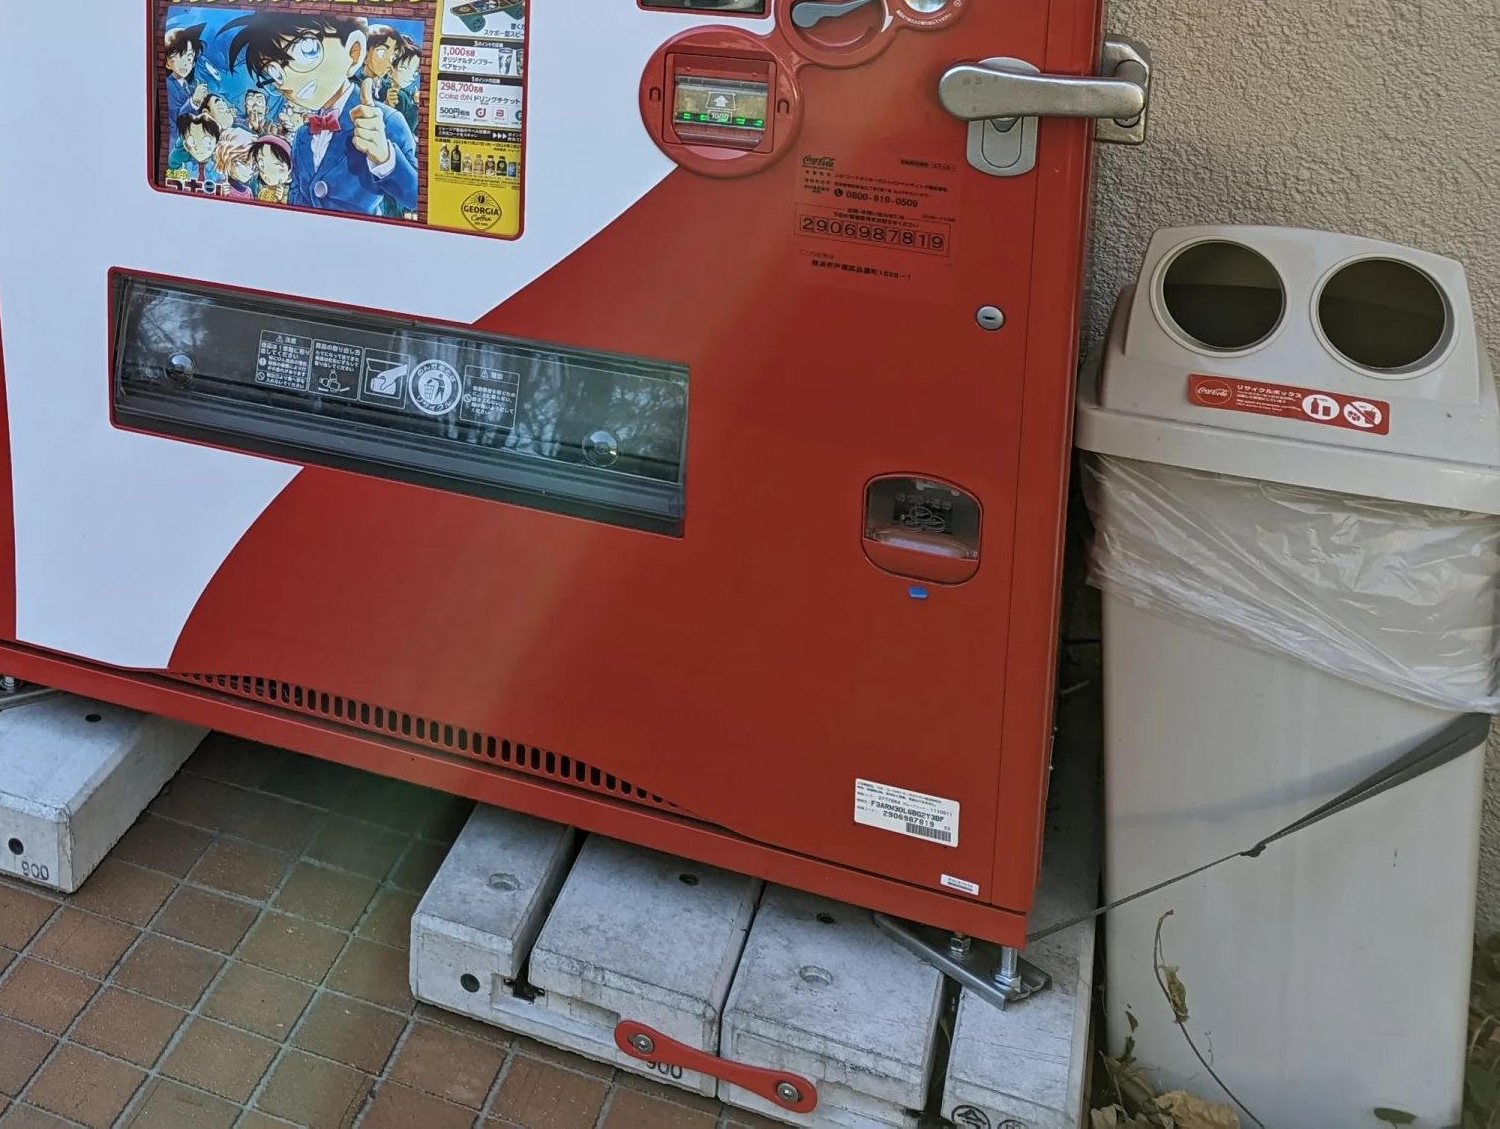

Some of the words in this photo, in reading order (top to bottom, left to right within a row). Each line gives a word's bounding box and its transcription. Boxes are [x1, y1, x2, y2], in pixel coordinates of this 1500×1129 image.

[439, 92, 459, 100] Coke
[464, 205, 499, 216] GEORGIA
[803, 217, 944, 249] 2906987819
[1236, 384, 1302, 398] リサイクルボックス
